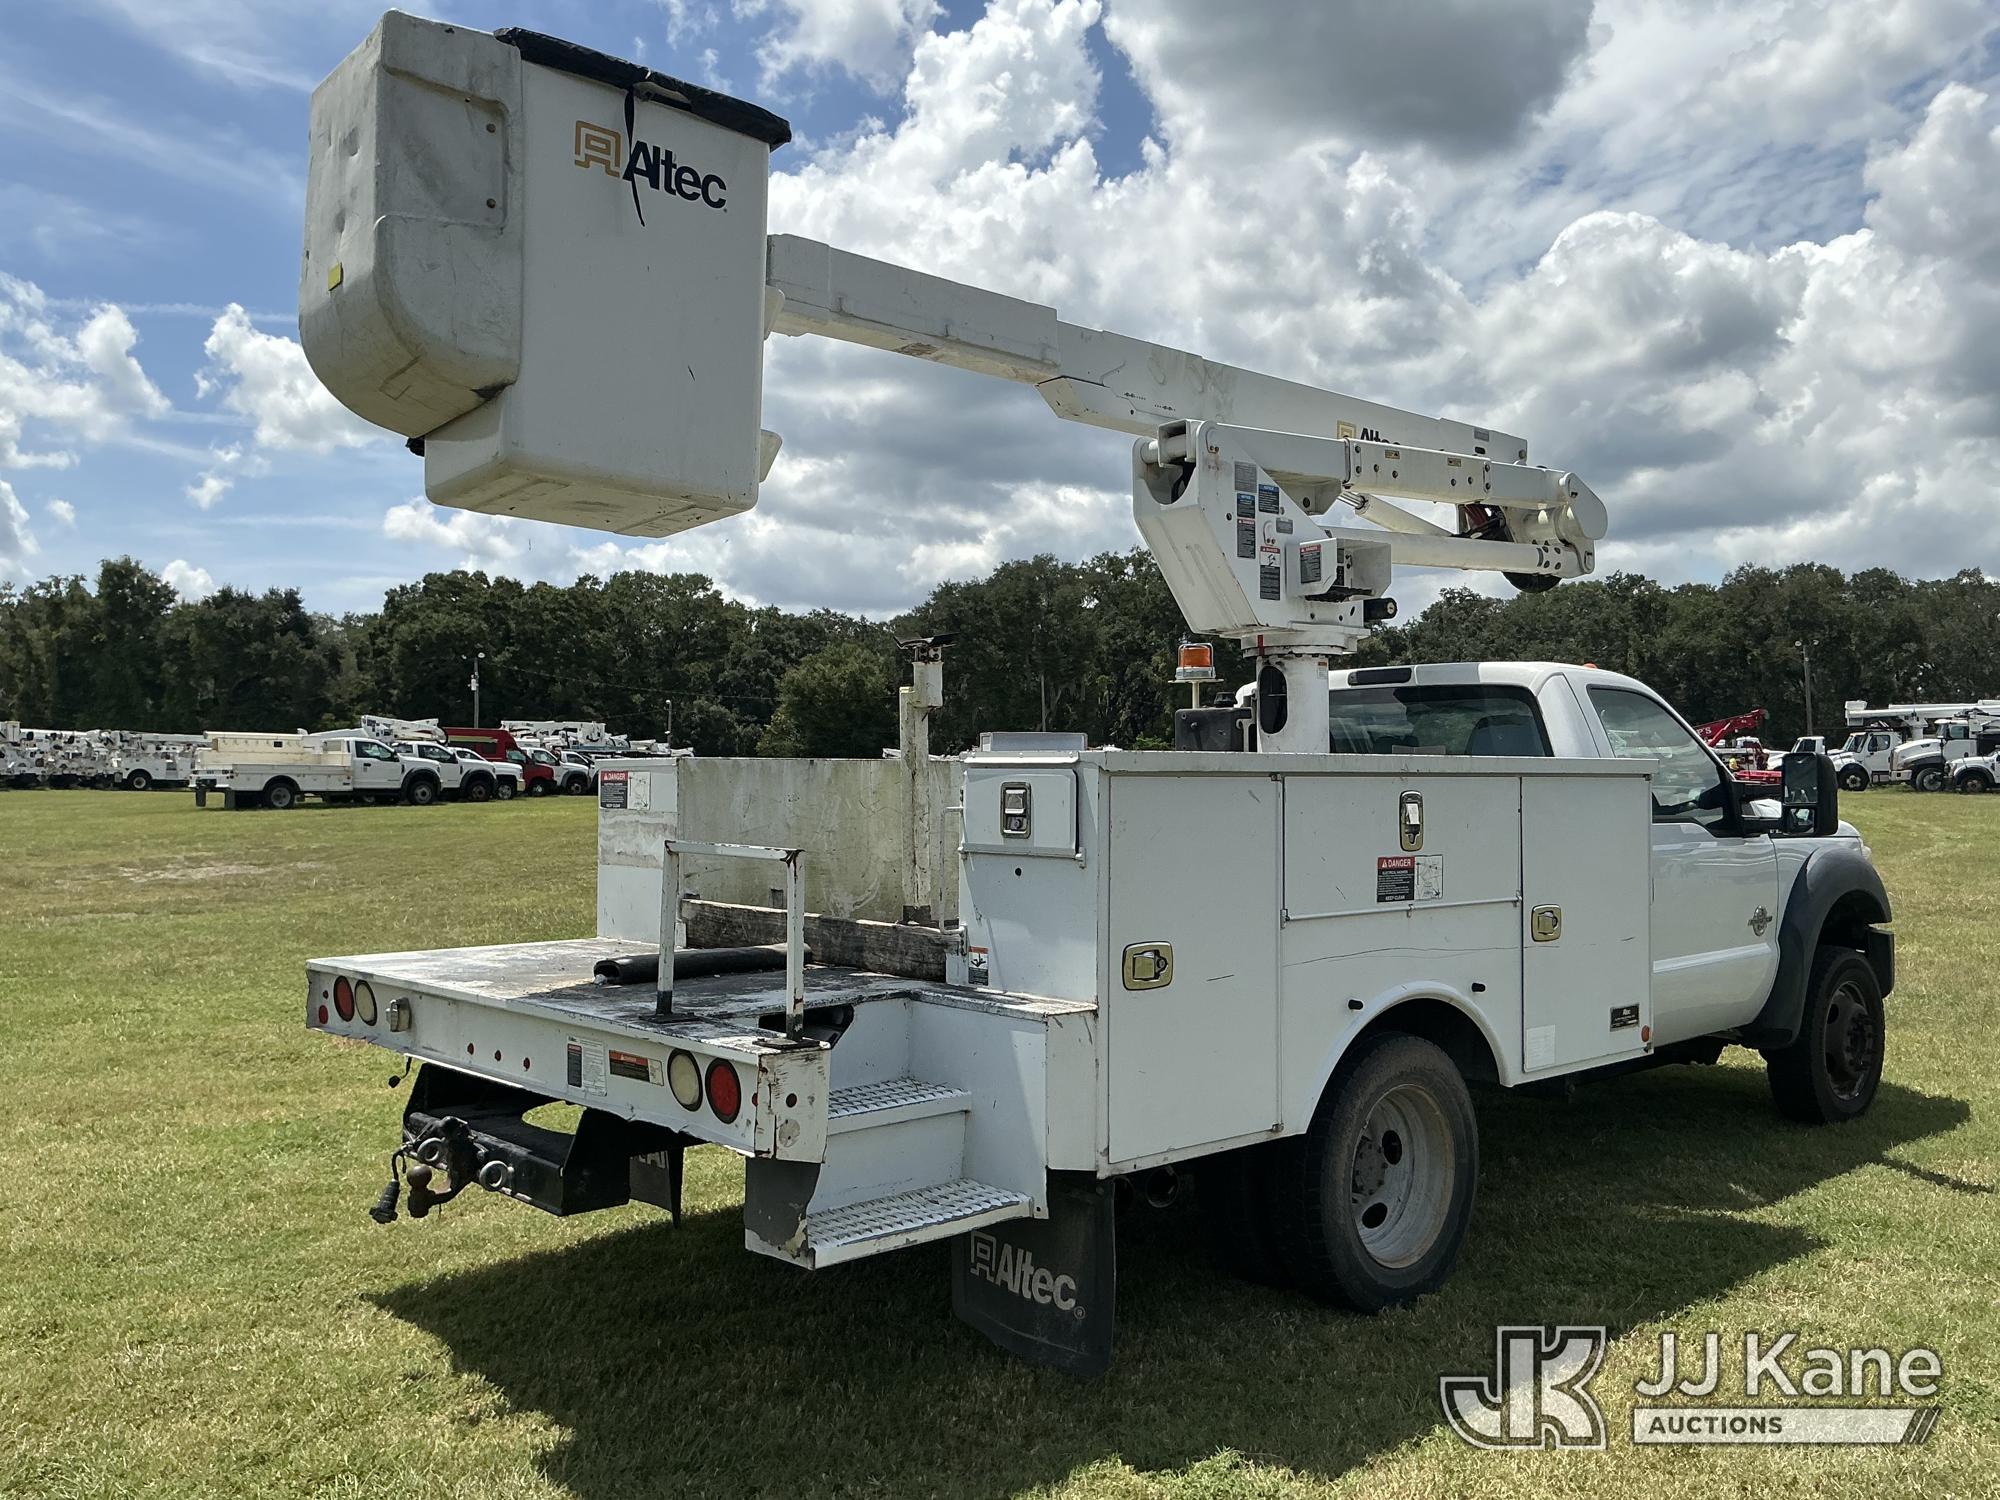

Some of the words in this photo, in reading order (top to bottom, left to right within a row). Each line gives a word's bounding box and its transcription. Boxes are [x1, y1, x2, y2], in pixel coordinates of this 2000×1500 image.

[622, 140, 727, 209] Altec
[608, 772, 626, 781] DANGER
[1388, 859, 1411, 868] DANGER
[995, 1243, 1077, 1311] Altec
